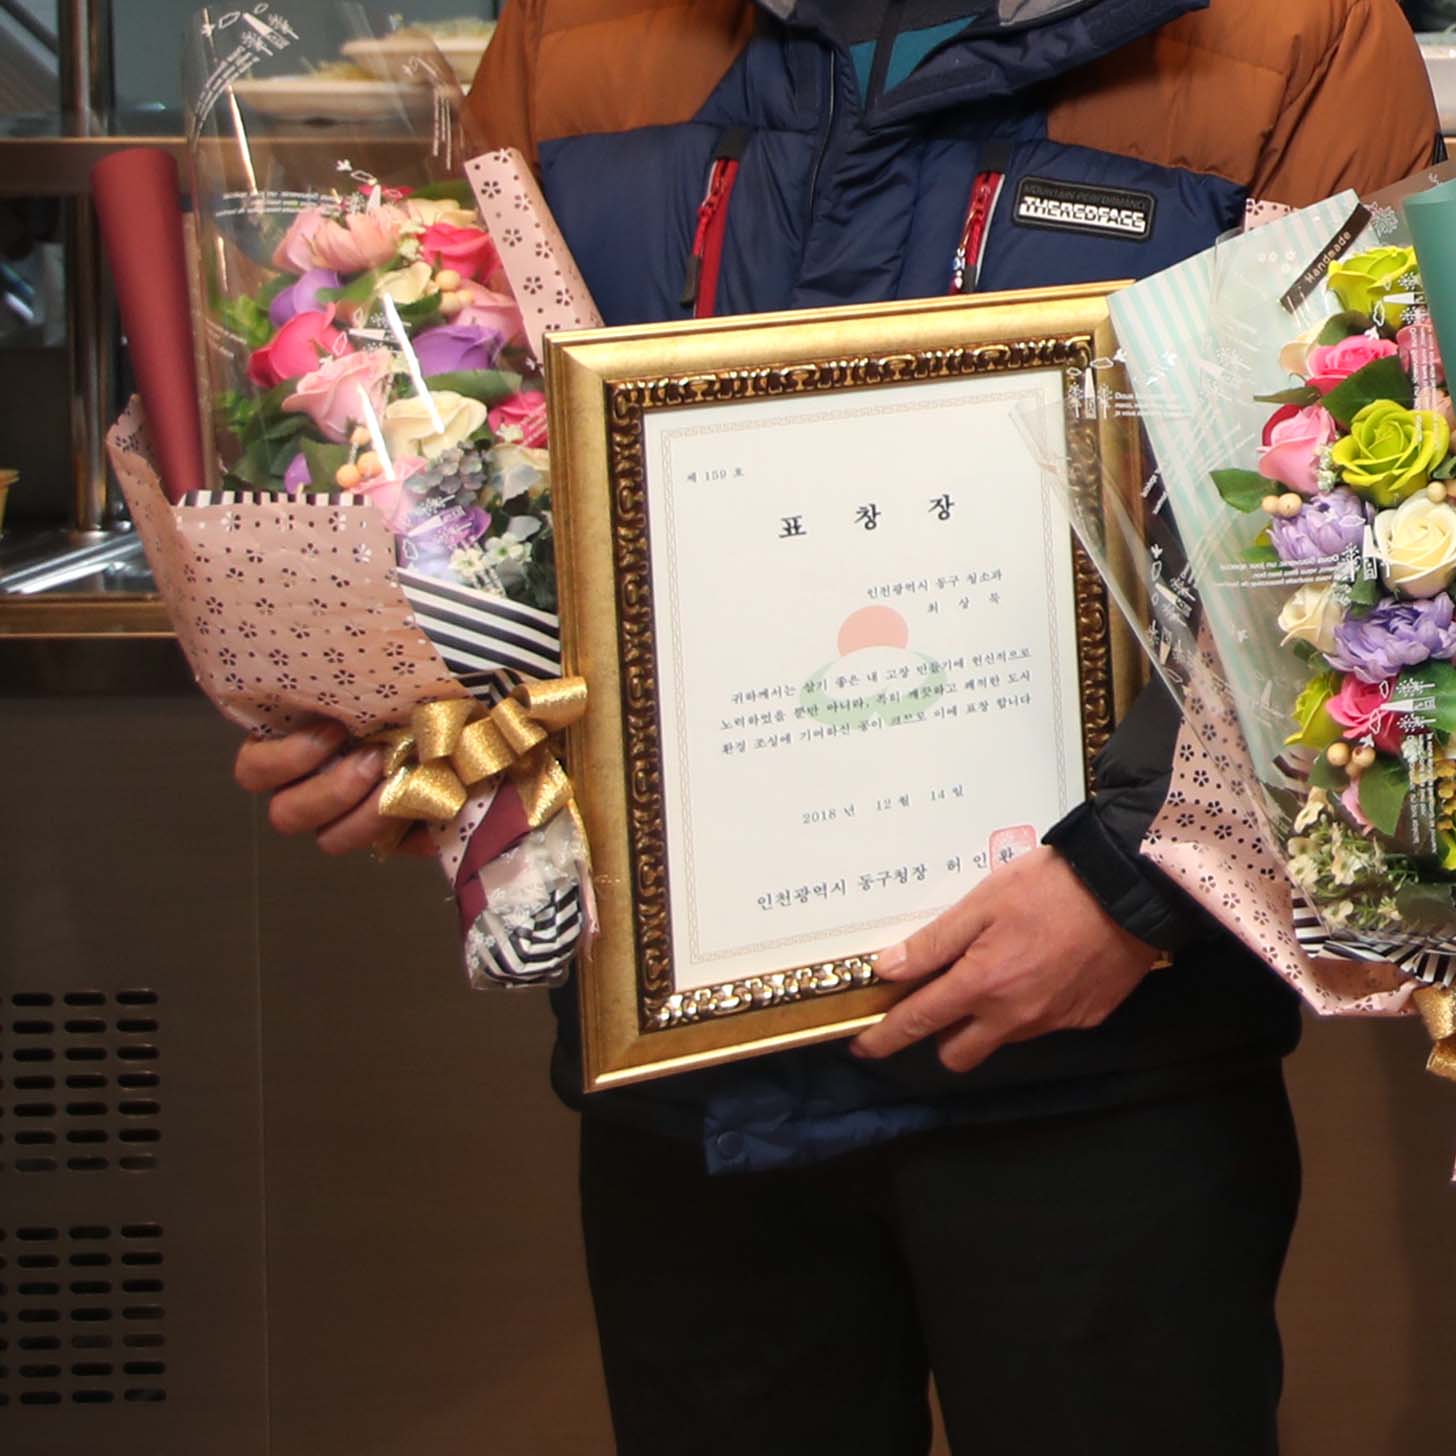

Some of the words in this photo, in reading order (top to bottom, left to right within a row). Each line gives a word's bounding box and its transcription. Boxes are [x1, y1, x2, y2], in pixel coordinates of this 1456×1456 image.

[1304, 230, 1352, 284] Handmade
[778, 514, 808, 539] 표
[854, 502, 882, 531] 창
[928, 493, 955, 521] 장
[802, 807, 838, 825] 2018
[875, 798, 893, 812] 12
[930, 788, 946, 803] 14
[757, 877, 848, 912] 인천광역시
[857, 862, 929, 892] 동구청장
